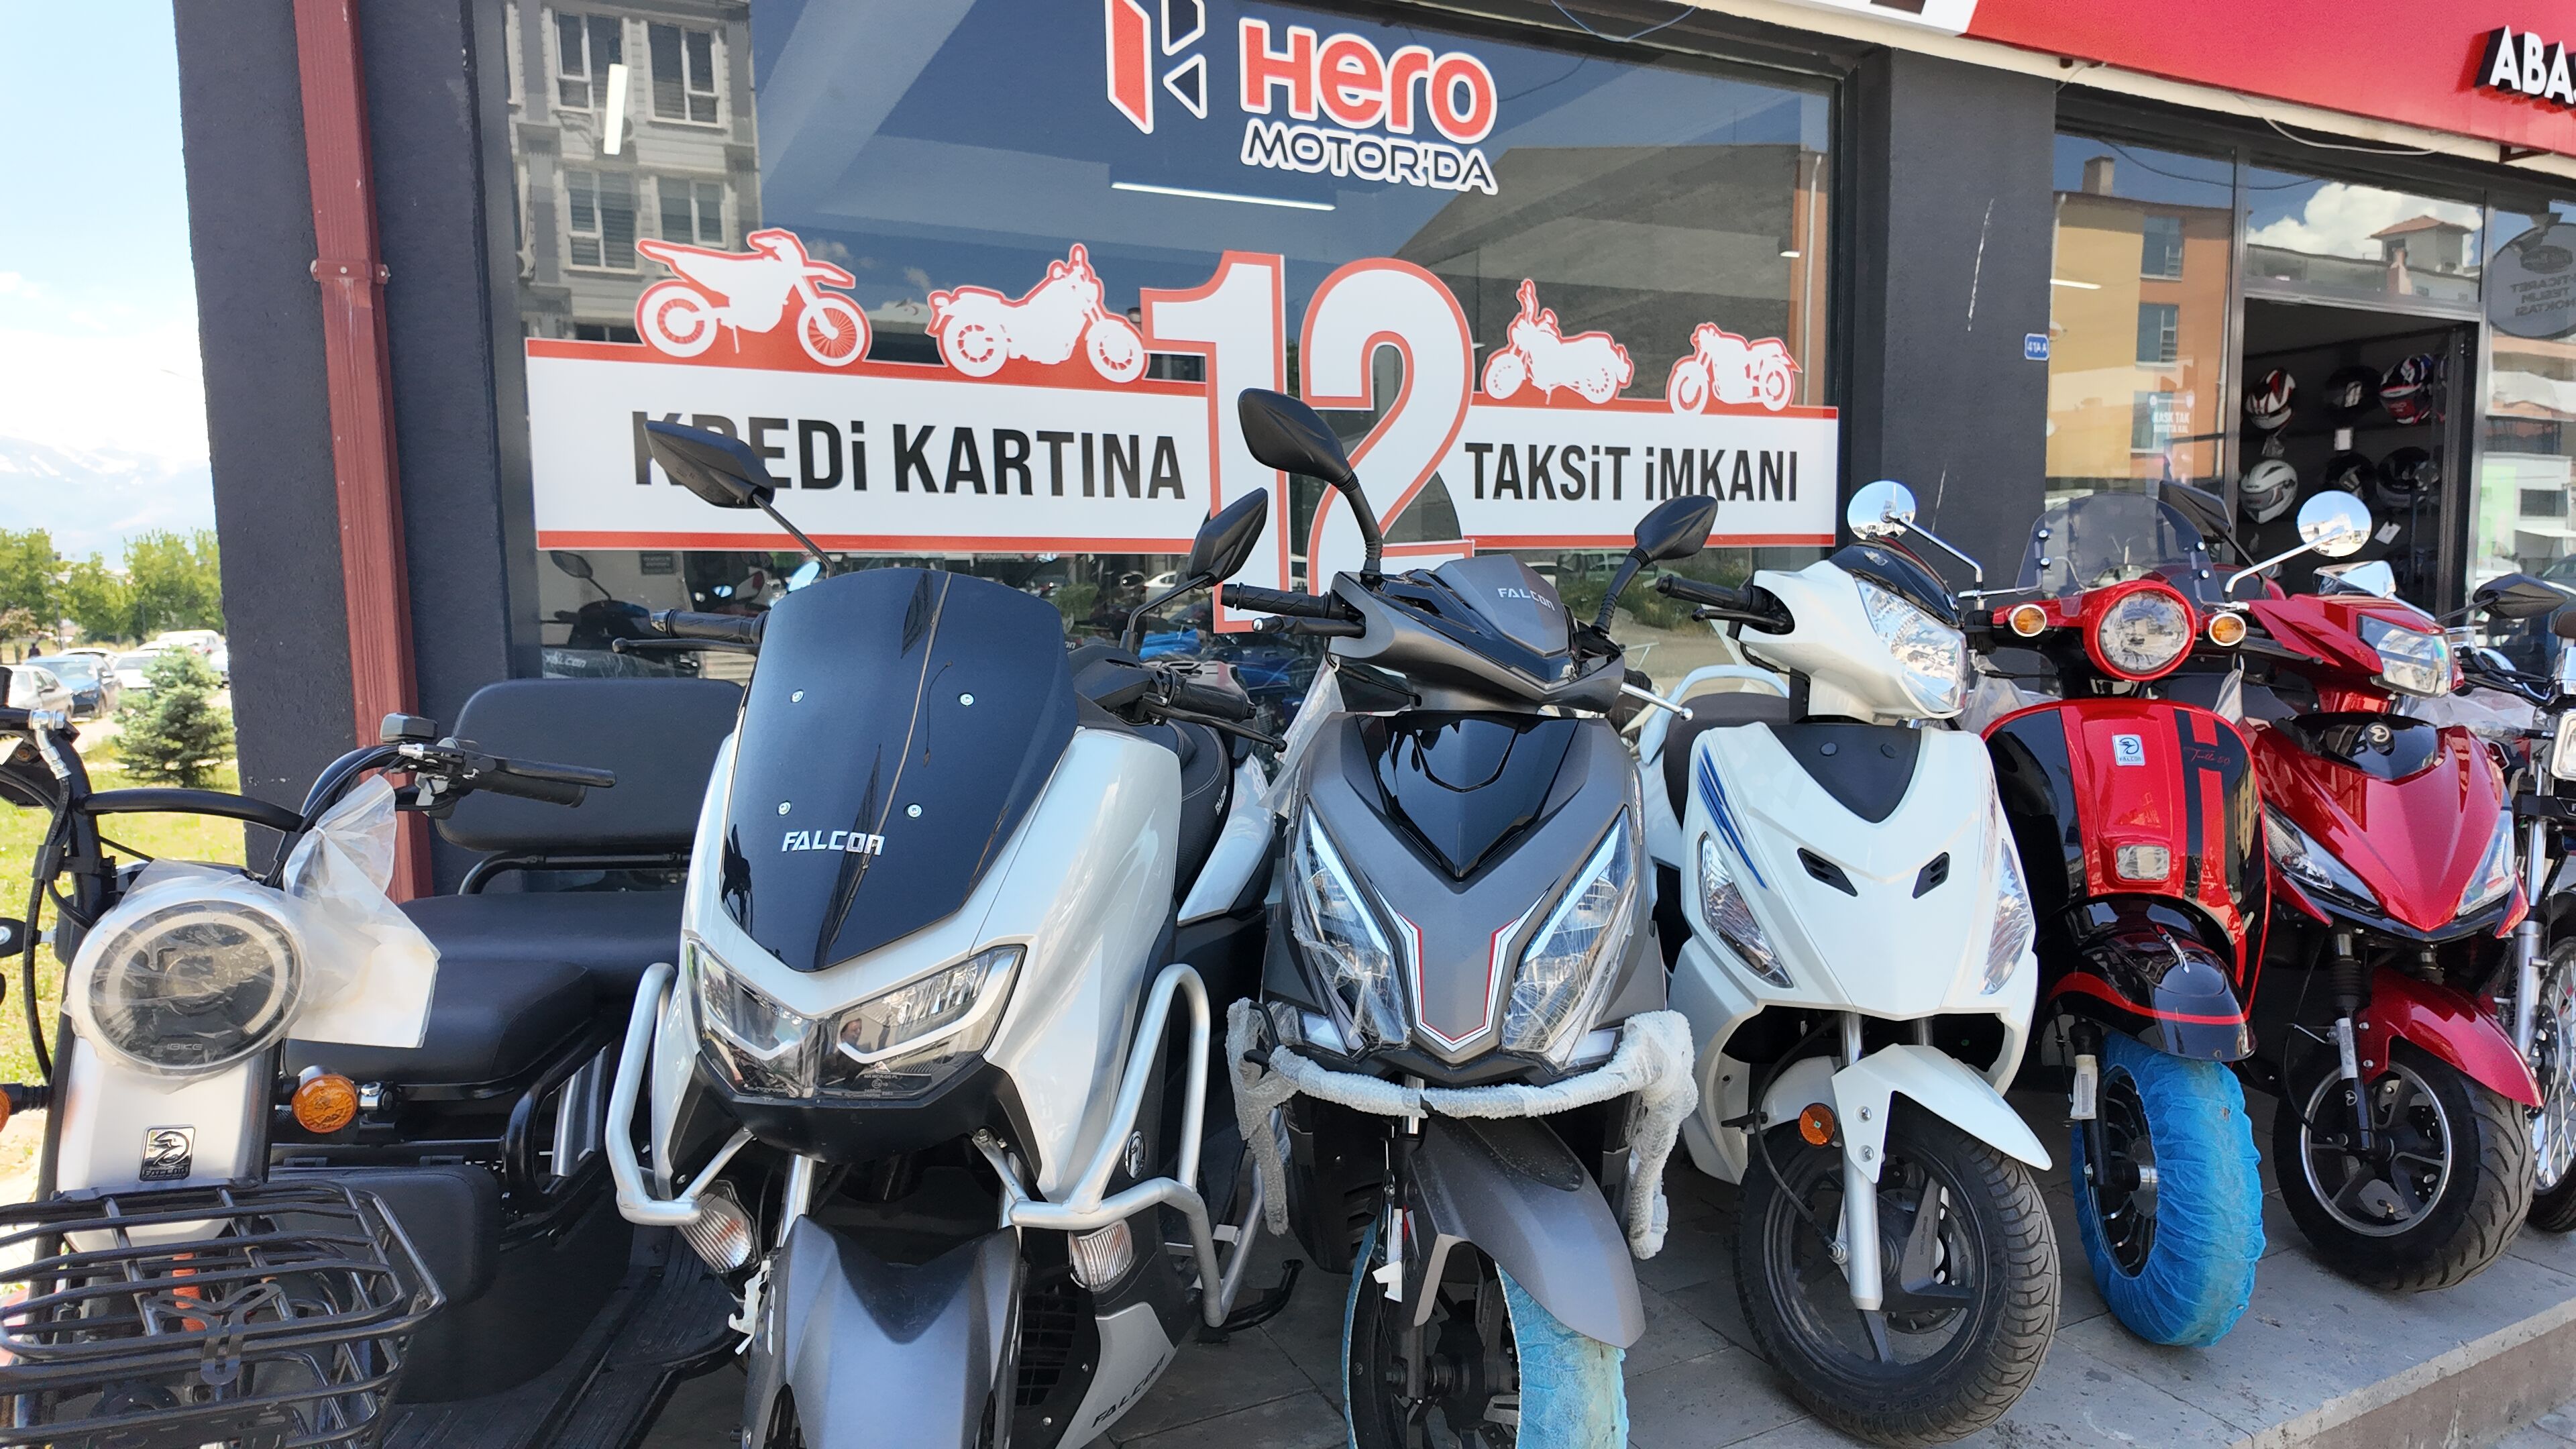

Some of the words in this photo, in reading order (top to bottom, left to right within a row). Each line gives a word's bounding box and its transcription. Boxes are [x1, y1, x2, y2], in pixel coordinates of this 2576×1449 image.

[1241, 20, 1496, 142] Hero
[2489, 24, 2576, 105] ABA
[893, 423, 1186, 500] KARTINA
[1140, 250, 1475, 634] 12
[1497, 588, 1556, 611] FALCON
[782, 830, 885, 856] FALCON
[1091, 1352, 1166, 1429] FALCON
